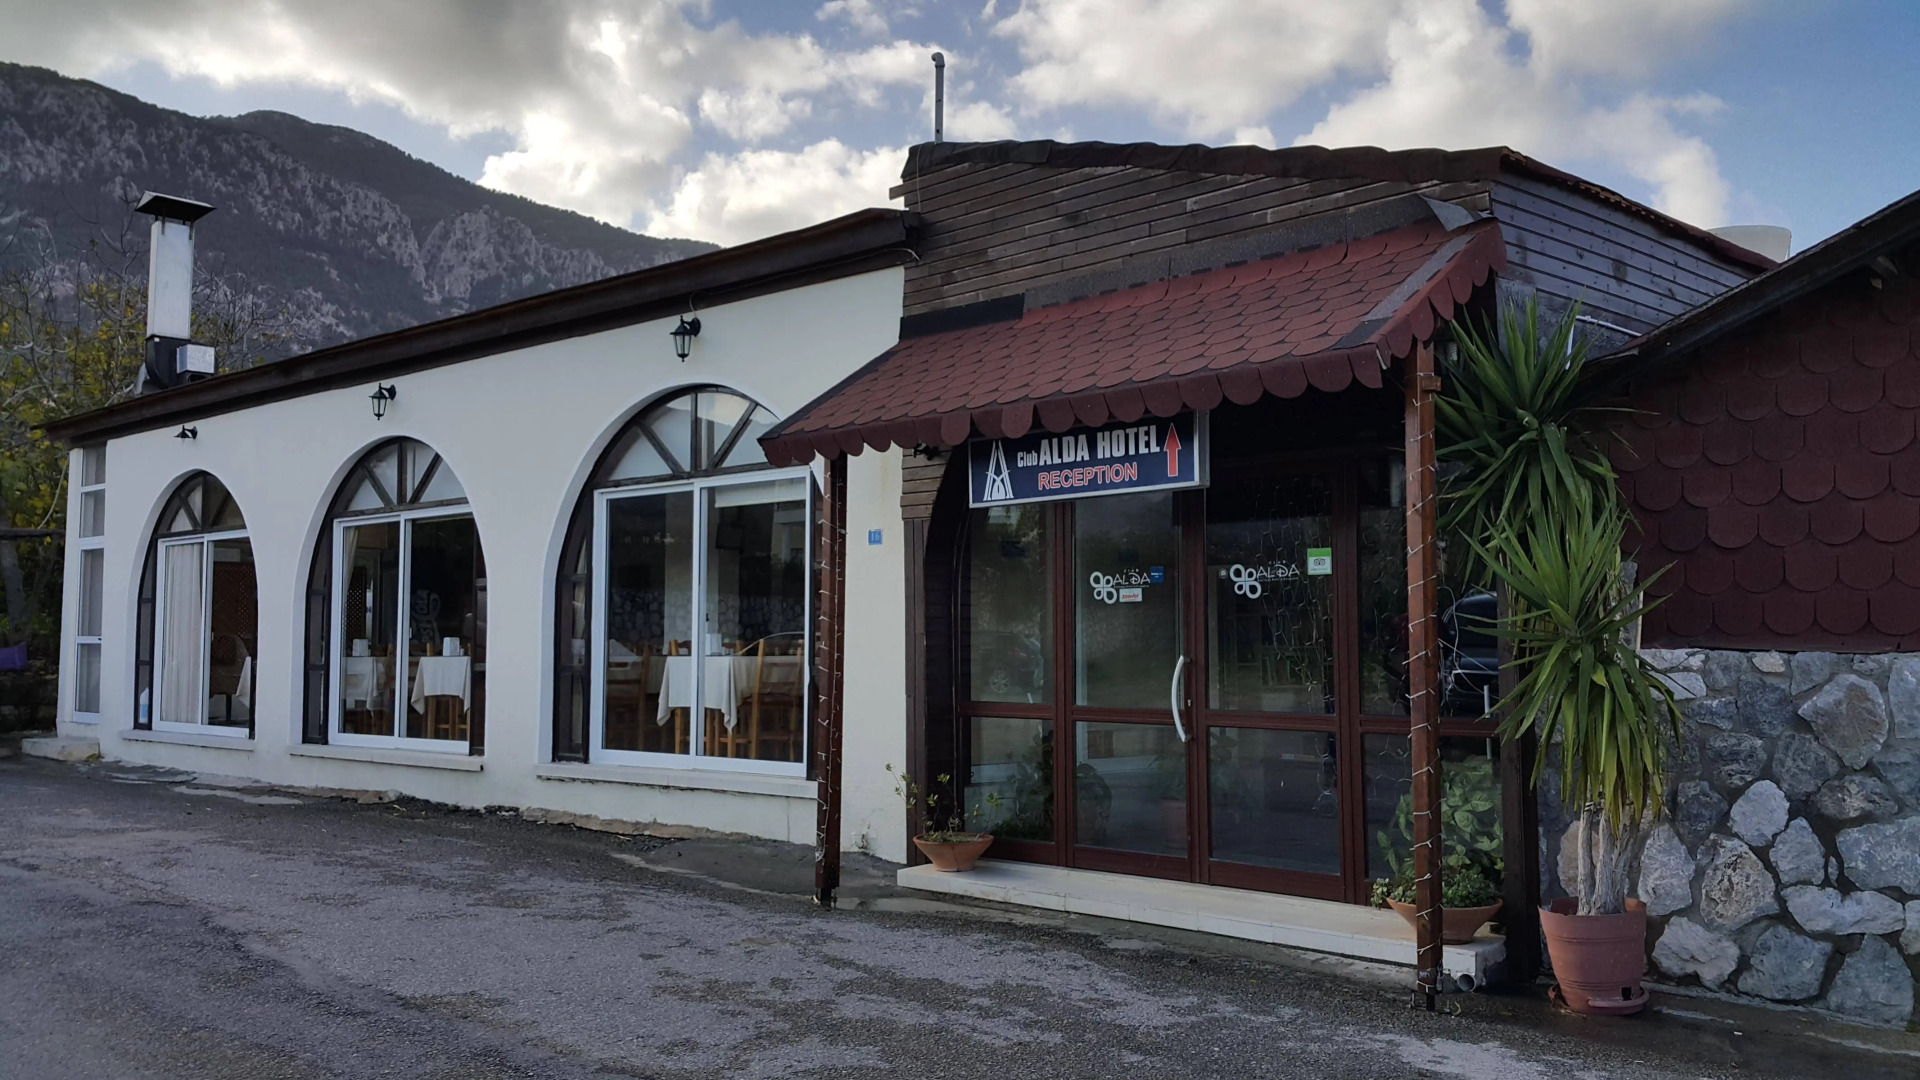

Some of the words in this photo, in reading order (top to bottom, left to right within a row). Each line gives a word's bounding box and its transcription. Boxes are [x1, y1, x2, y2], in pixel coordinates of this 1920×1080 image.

[1017, 450, 1038, 468] Club
[1038, 434, 1090, 466] ALDA
[1097, 424, 1161, 460] HOTEL
[1038, 462, 1138, 491] RECEPTION
[870, 532, 880, 541] 16
[1256, 564, 1300, 578] ALDA
[1113, 572, 1150, 585] ALDA
